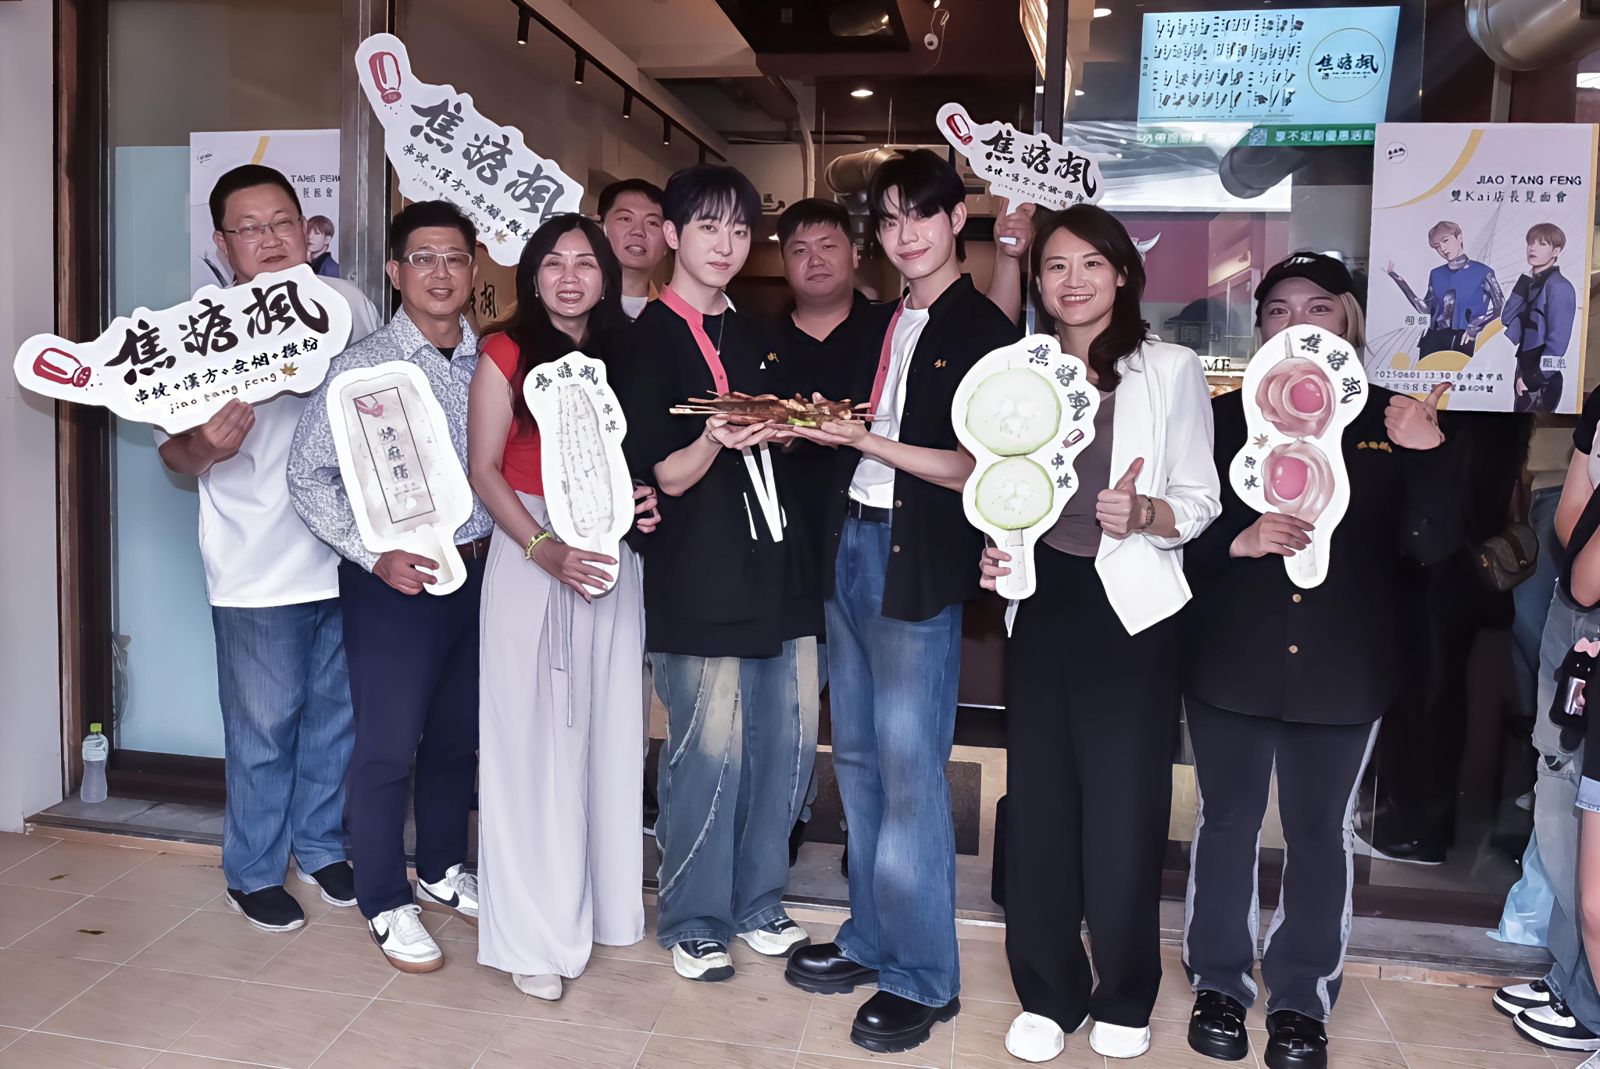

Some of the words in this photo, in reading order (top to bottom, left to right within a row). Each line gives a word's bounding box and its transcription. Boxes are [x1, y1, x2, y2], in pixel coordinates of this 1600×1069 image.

[981, 129, 1097, 198] 焦糖楓
[1476, 175, 1505, 185] JIAO
[1510, 175, 1544, 185] TANG
[1550, 175, 1582, 185] FENG
[104, 280, 329, 385] 焦糖楓
